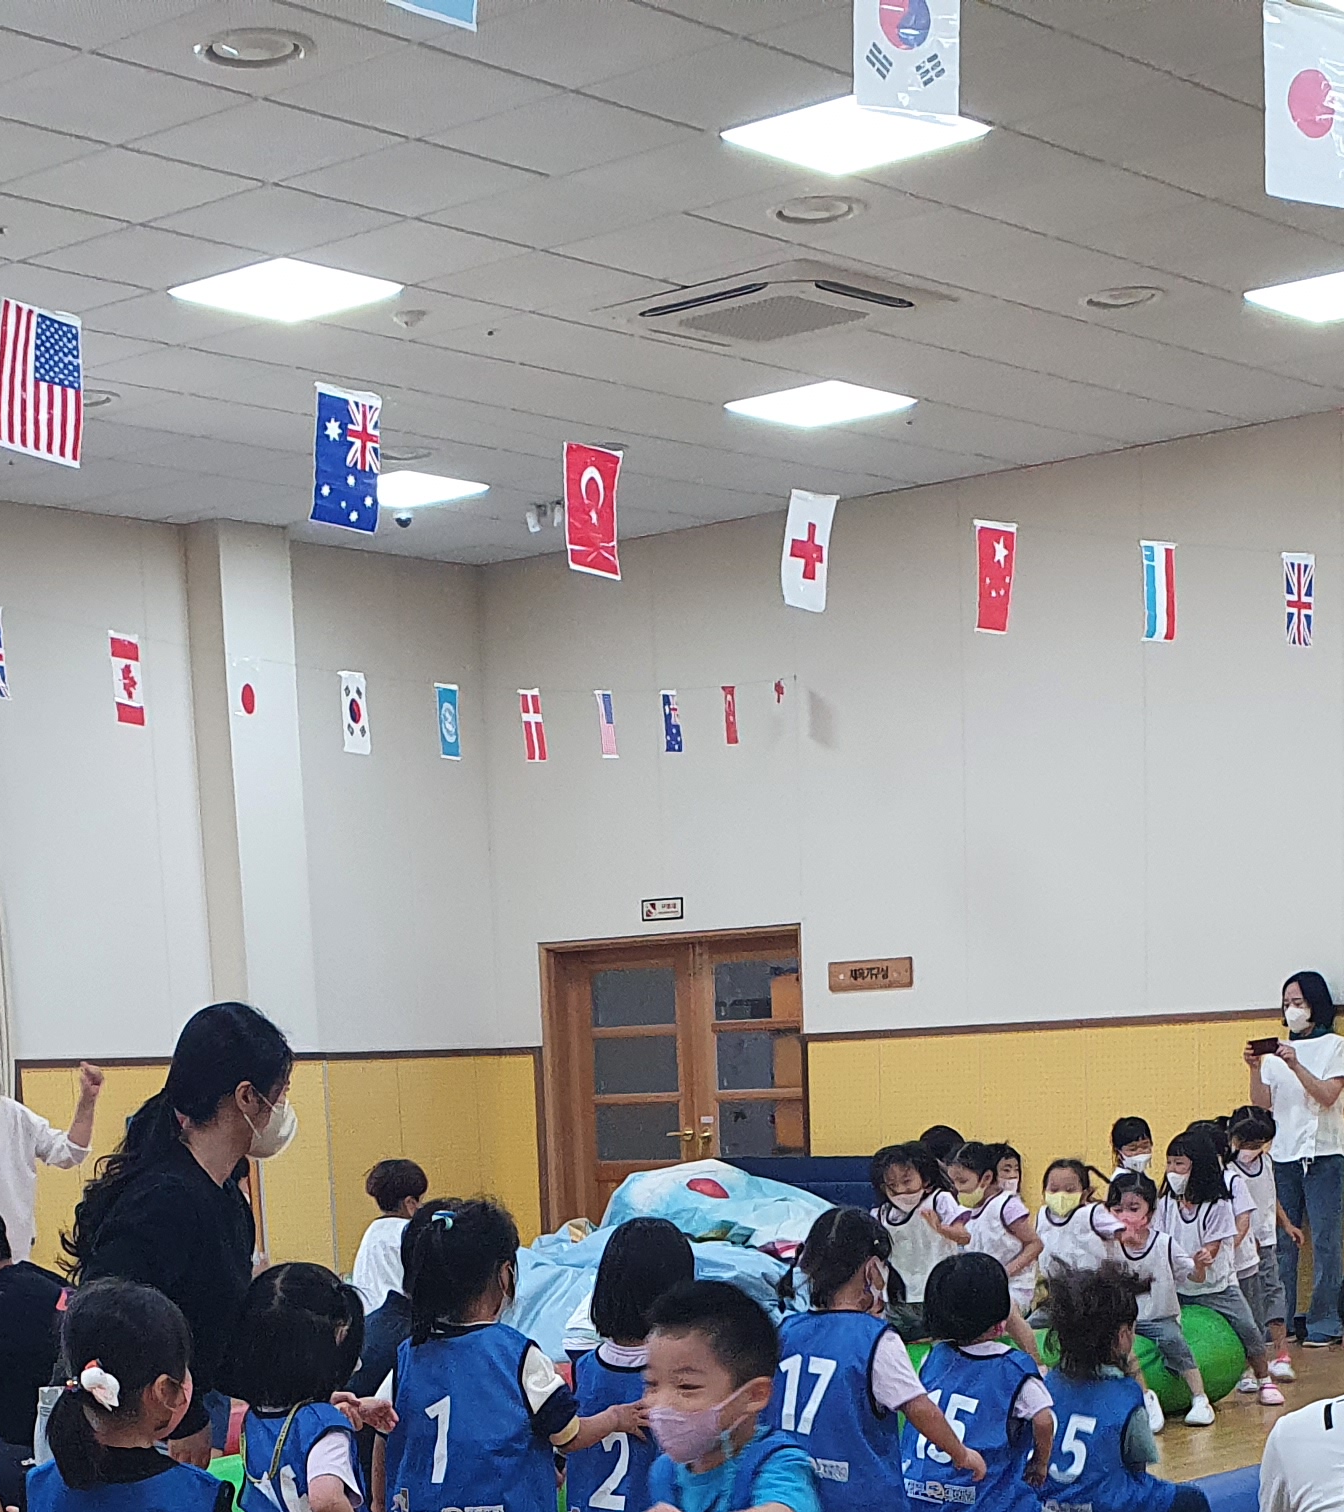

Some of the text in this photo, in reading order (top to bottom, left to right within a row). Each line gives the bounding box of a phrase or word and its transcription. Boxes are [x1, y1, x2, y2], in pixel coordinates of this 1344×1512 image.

[779, 1353, 837, 1436] 17
[424, 1395, 451, 1483] 1
[588, 1431, 630, 1511] 2
